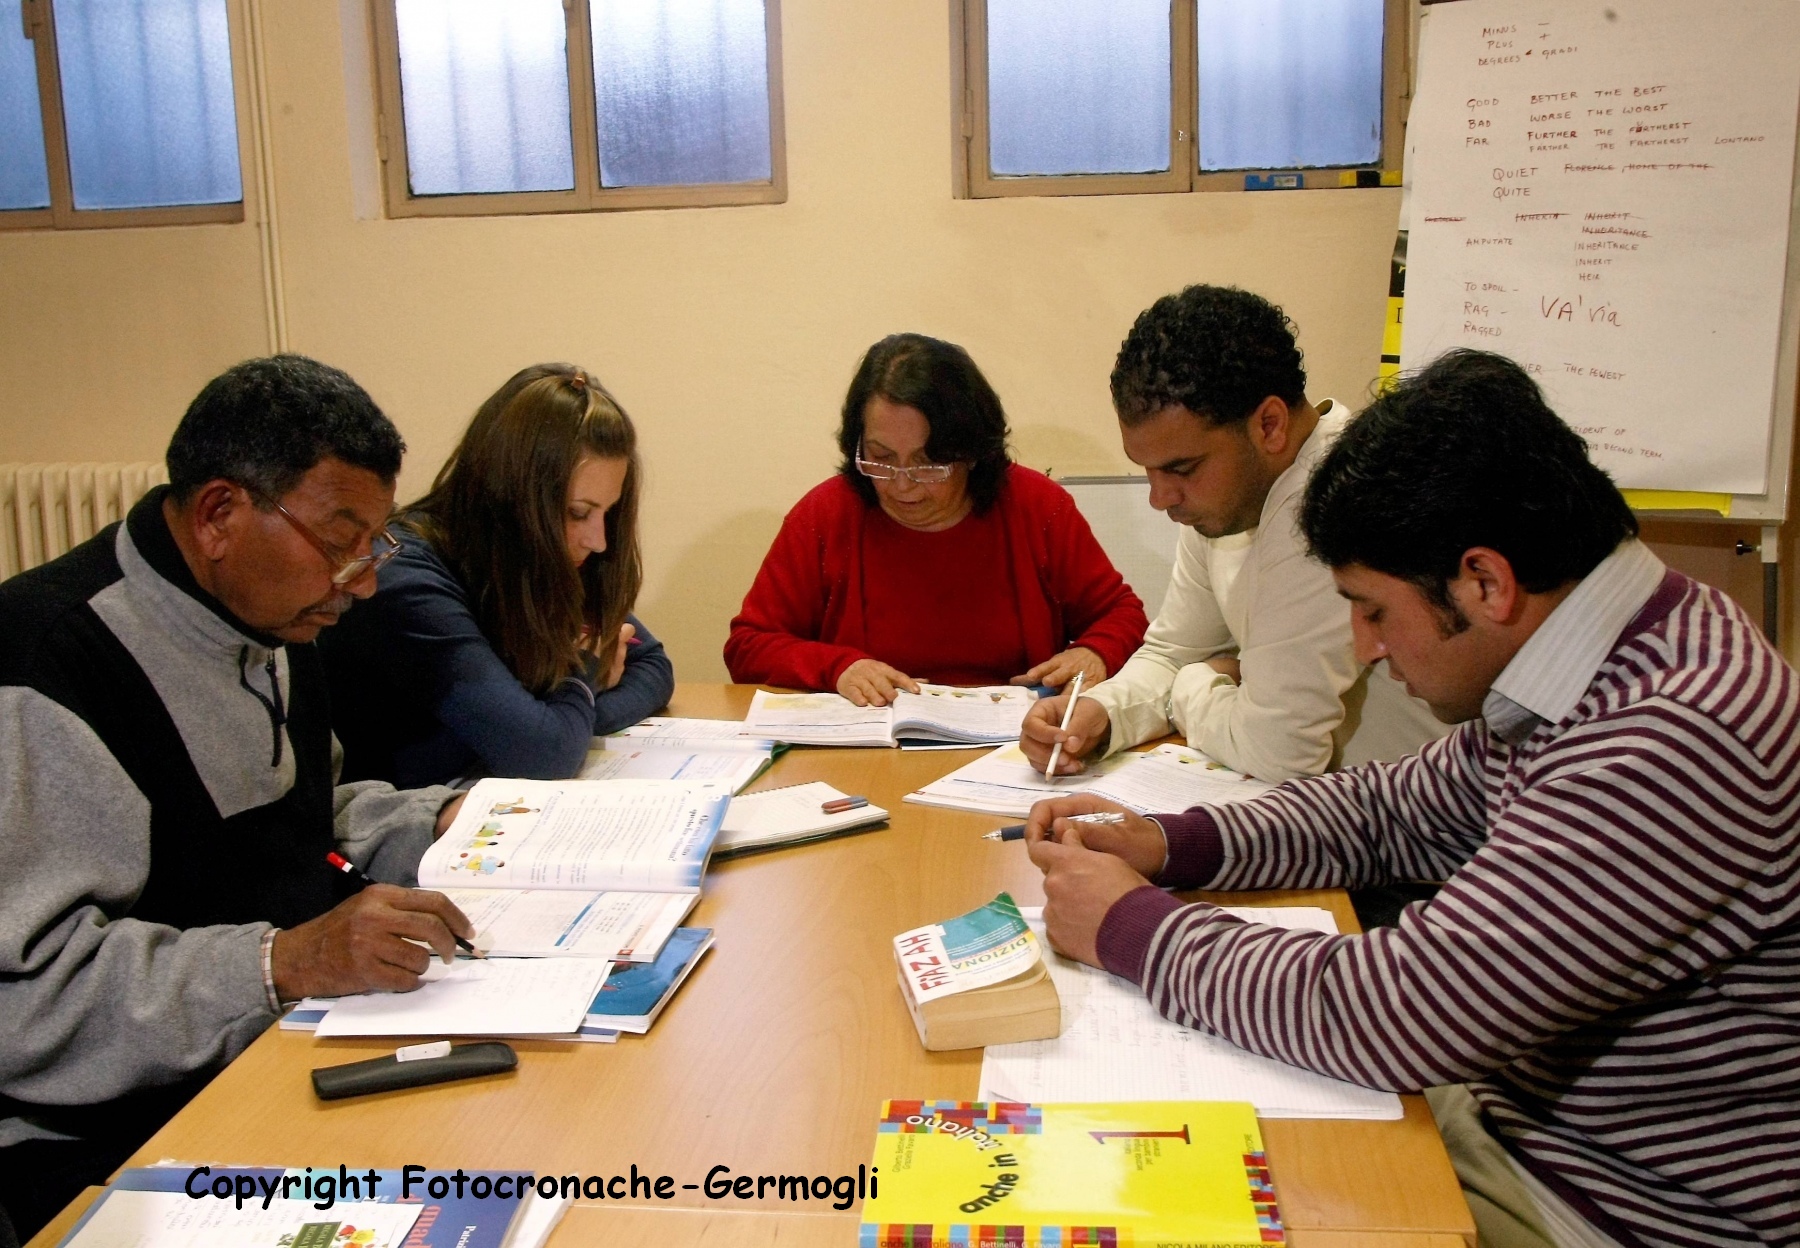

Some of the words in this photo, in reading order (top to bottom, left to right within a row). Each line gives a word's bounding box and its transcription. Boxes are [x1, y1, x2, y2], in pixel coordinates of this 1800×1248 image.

[1482, 24, 1517, 37] MINUS
[1487, 40, 1513, 50] PLUS
[1478, 55, 1521, 66] DEGREES
[1542, 46, 1578, 59] GRADI
[1466, 98, 1500, 112] GOOD
[1530, 91, 1578, 104] BETTER
[1595, 88, 1622, 97] THE
[1633, 86, 1666, 97] BEST
[1468, 119, 1491, 129] BAD
[1530, 111, 1572, 122] WORSE
[1588, 109, 1613, 117] THE
[1623, 103, 1668, 114] WORST
[1466, 137, 1489, 148] FAR
[1527, 131, 1578, 141] FURTHER
[1594, 129, 1614, 137] THE
[1529, 144, 1569, 152] FARTHER
[1715, 136, 1765, 145] LONTANO
[1492, 167, 1538, 182] QUIET
[1493, 187, 1530, 202] QUITE
[1466, 238, 1513, 247] AMPUTATE
[1574, 241, 1639, 251] INHERITANCE
[1575, 258, 1612, 266] INHERIT
[1579, 273, 1600, 281] HEIR
[1465, 282, 1477, 291] TO
[1482, 283, 1506, 292] SPOIL
[1464, 301, 1489, 317] RAG
[1464, 321, 1502, 337] RAGGED
[1564, 358, 1583, 375] THE
[1590, 363, 1626, 380] FEWEST
[951, 937, 1028, 970] DIZIONA
[906, 1115, 1004, 1152] italiano
[1088, 1124, 1191, 1145] 1
[988, 1153, 1019, 1168] in
[959, 1173, 1020, 1213] anche
